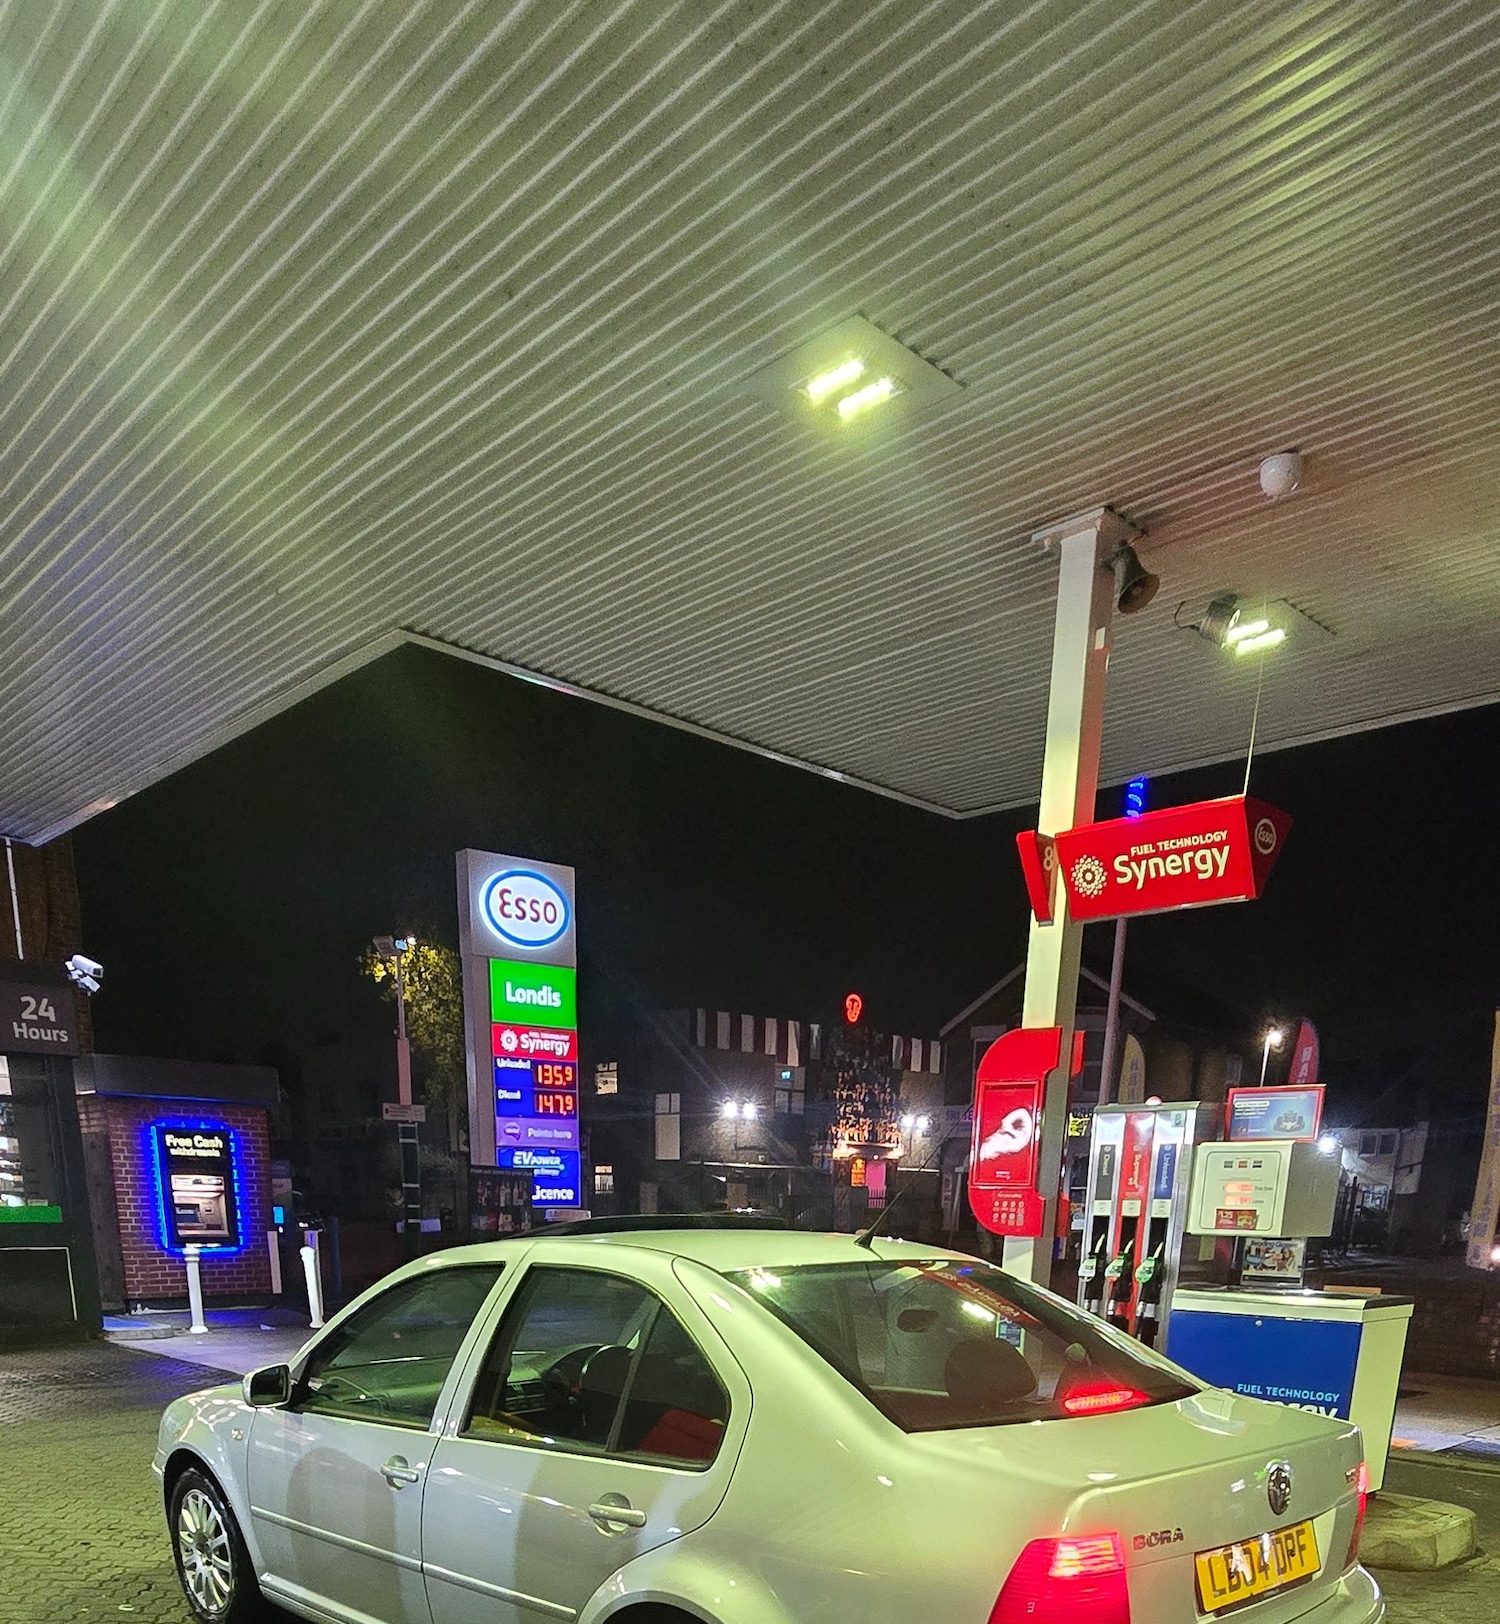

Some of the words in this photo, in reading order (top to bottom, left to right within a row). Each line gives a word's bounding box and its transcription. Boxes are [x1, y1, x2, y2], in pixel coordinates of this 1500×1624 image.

[1130, 843, 1156, 857] FUEL
[1156, 829, 1228, 851] TECHNOLOGY
[1043, 846, 1054, 871] 8
[1113, 845, 1230, 890] Synergy
[498, 887, 557, 925] Esso
[505, 980, 562, 1008] Londis
[20, 995, 56, 1022] 24
[12, 1021, 69, 1043] Hours
[520, 1033, 570, 1057] Synergy
[537, 1064, 573, 1086] 135.9
[538, 1094, 574, 1116] 147.9
[165, 1134, 193, 1147] Free
[193, 1135, 223, 1149] Cash
[1237, 1383, 1263, 1395] FUEL
[1265, 1386, 1340, 1403] TECHNOLOGY
[1133, 1527, 1184, 1550] BORA
[1272, 1528, 1307, 1576] DPF
